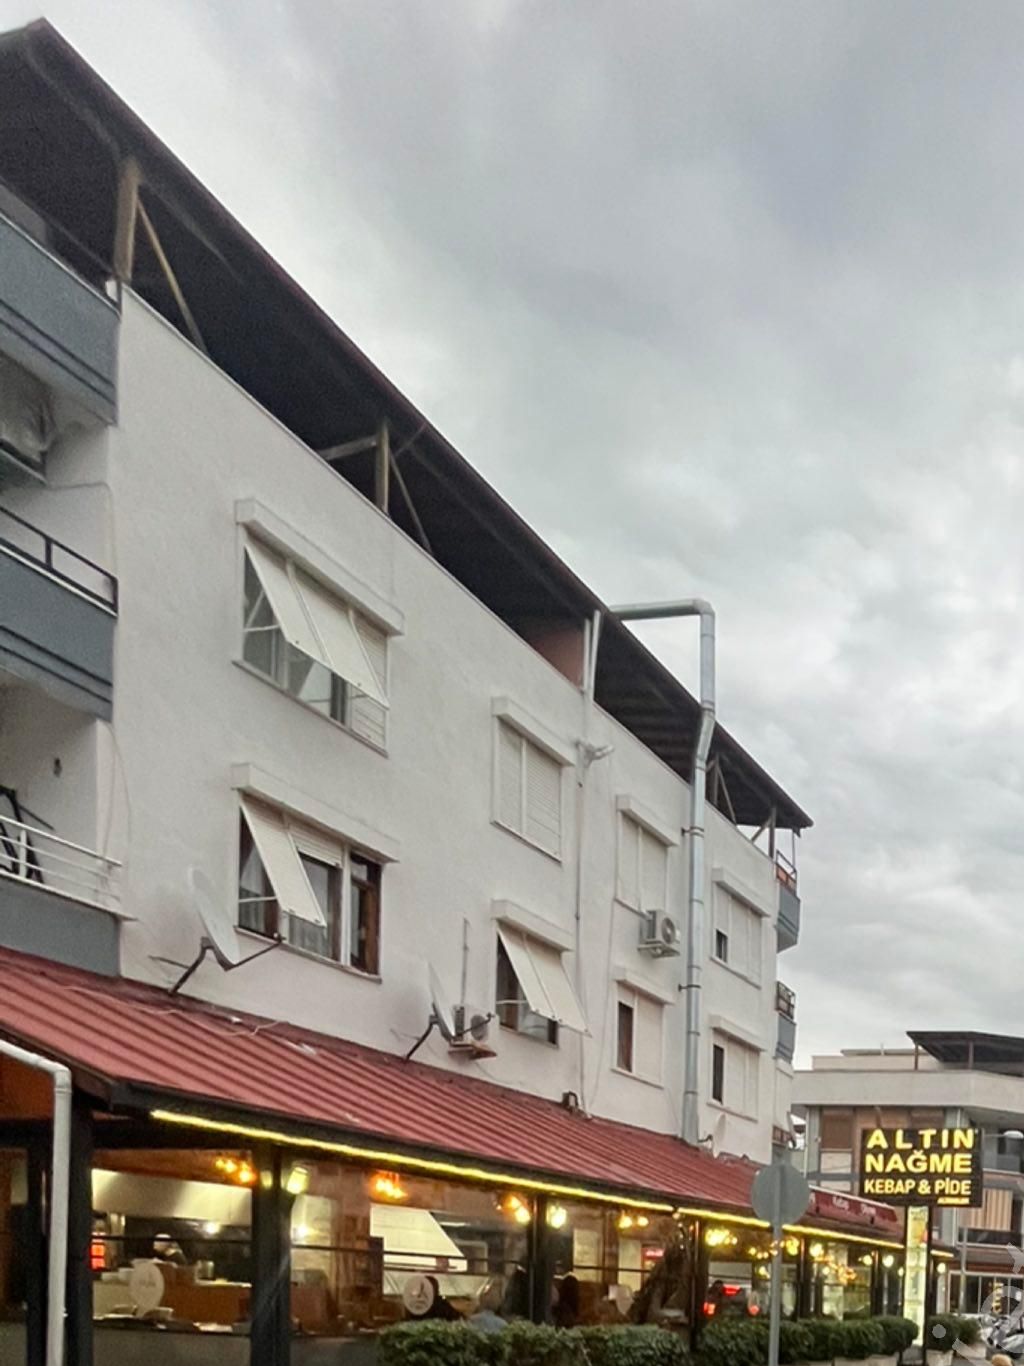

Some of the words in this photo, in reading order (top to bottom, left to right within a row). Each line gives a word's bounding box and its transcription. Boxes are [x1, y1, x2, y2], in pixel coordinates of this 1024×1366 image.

[866, 1128, 974, 1149] ALTIN
[865, 1149, 972, 1173] NAĞME
[864, 1179, 915, 1194] KEBAP
[917, 1179, 931, 1195] &
[934, 1177, 971, 1195] PİDE
